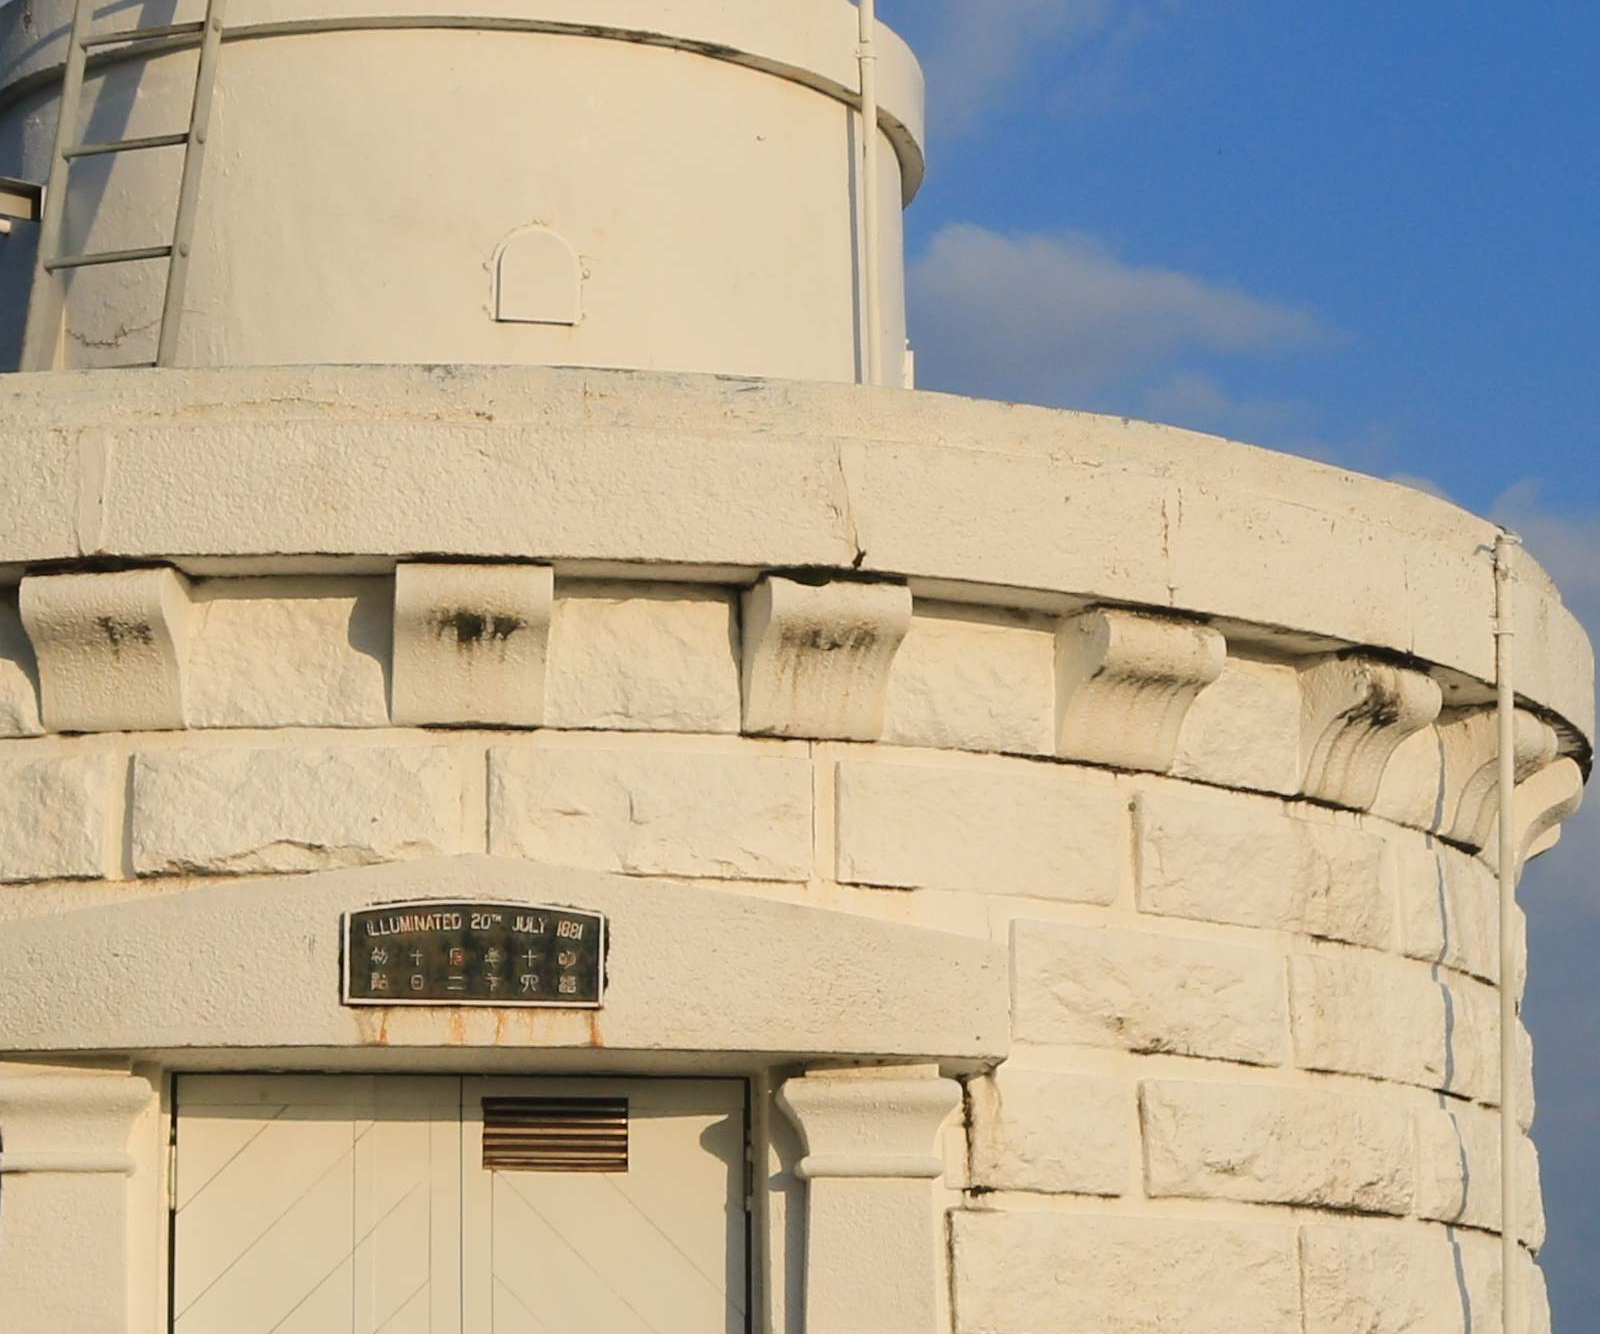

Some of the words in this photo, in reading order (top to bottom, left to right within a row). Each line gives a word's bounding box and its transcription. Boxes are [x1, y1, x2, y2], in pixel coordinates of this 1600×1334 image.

[367, 913, 462, 937] ILLUMINATED
[512, 916, 547, 934] JULY
[557, 920, 583, 940] 1881
